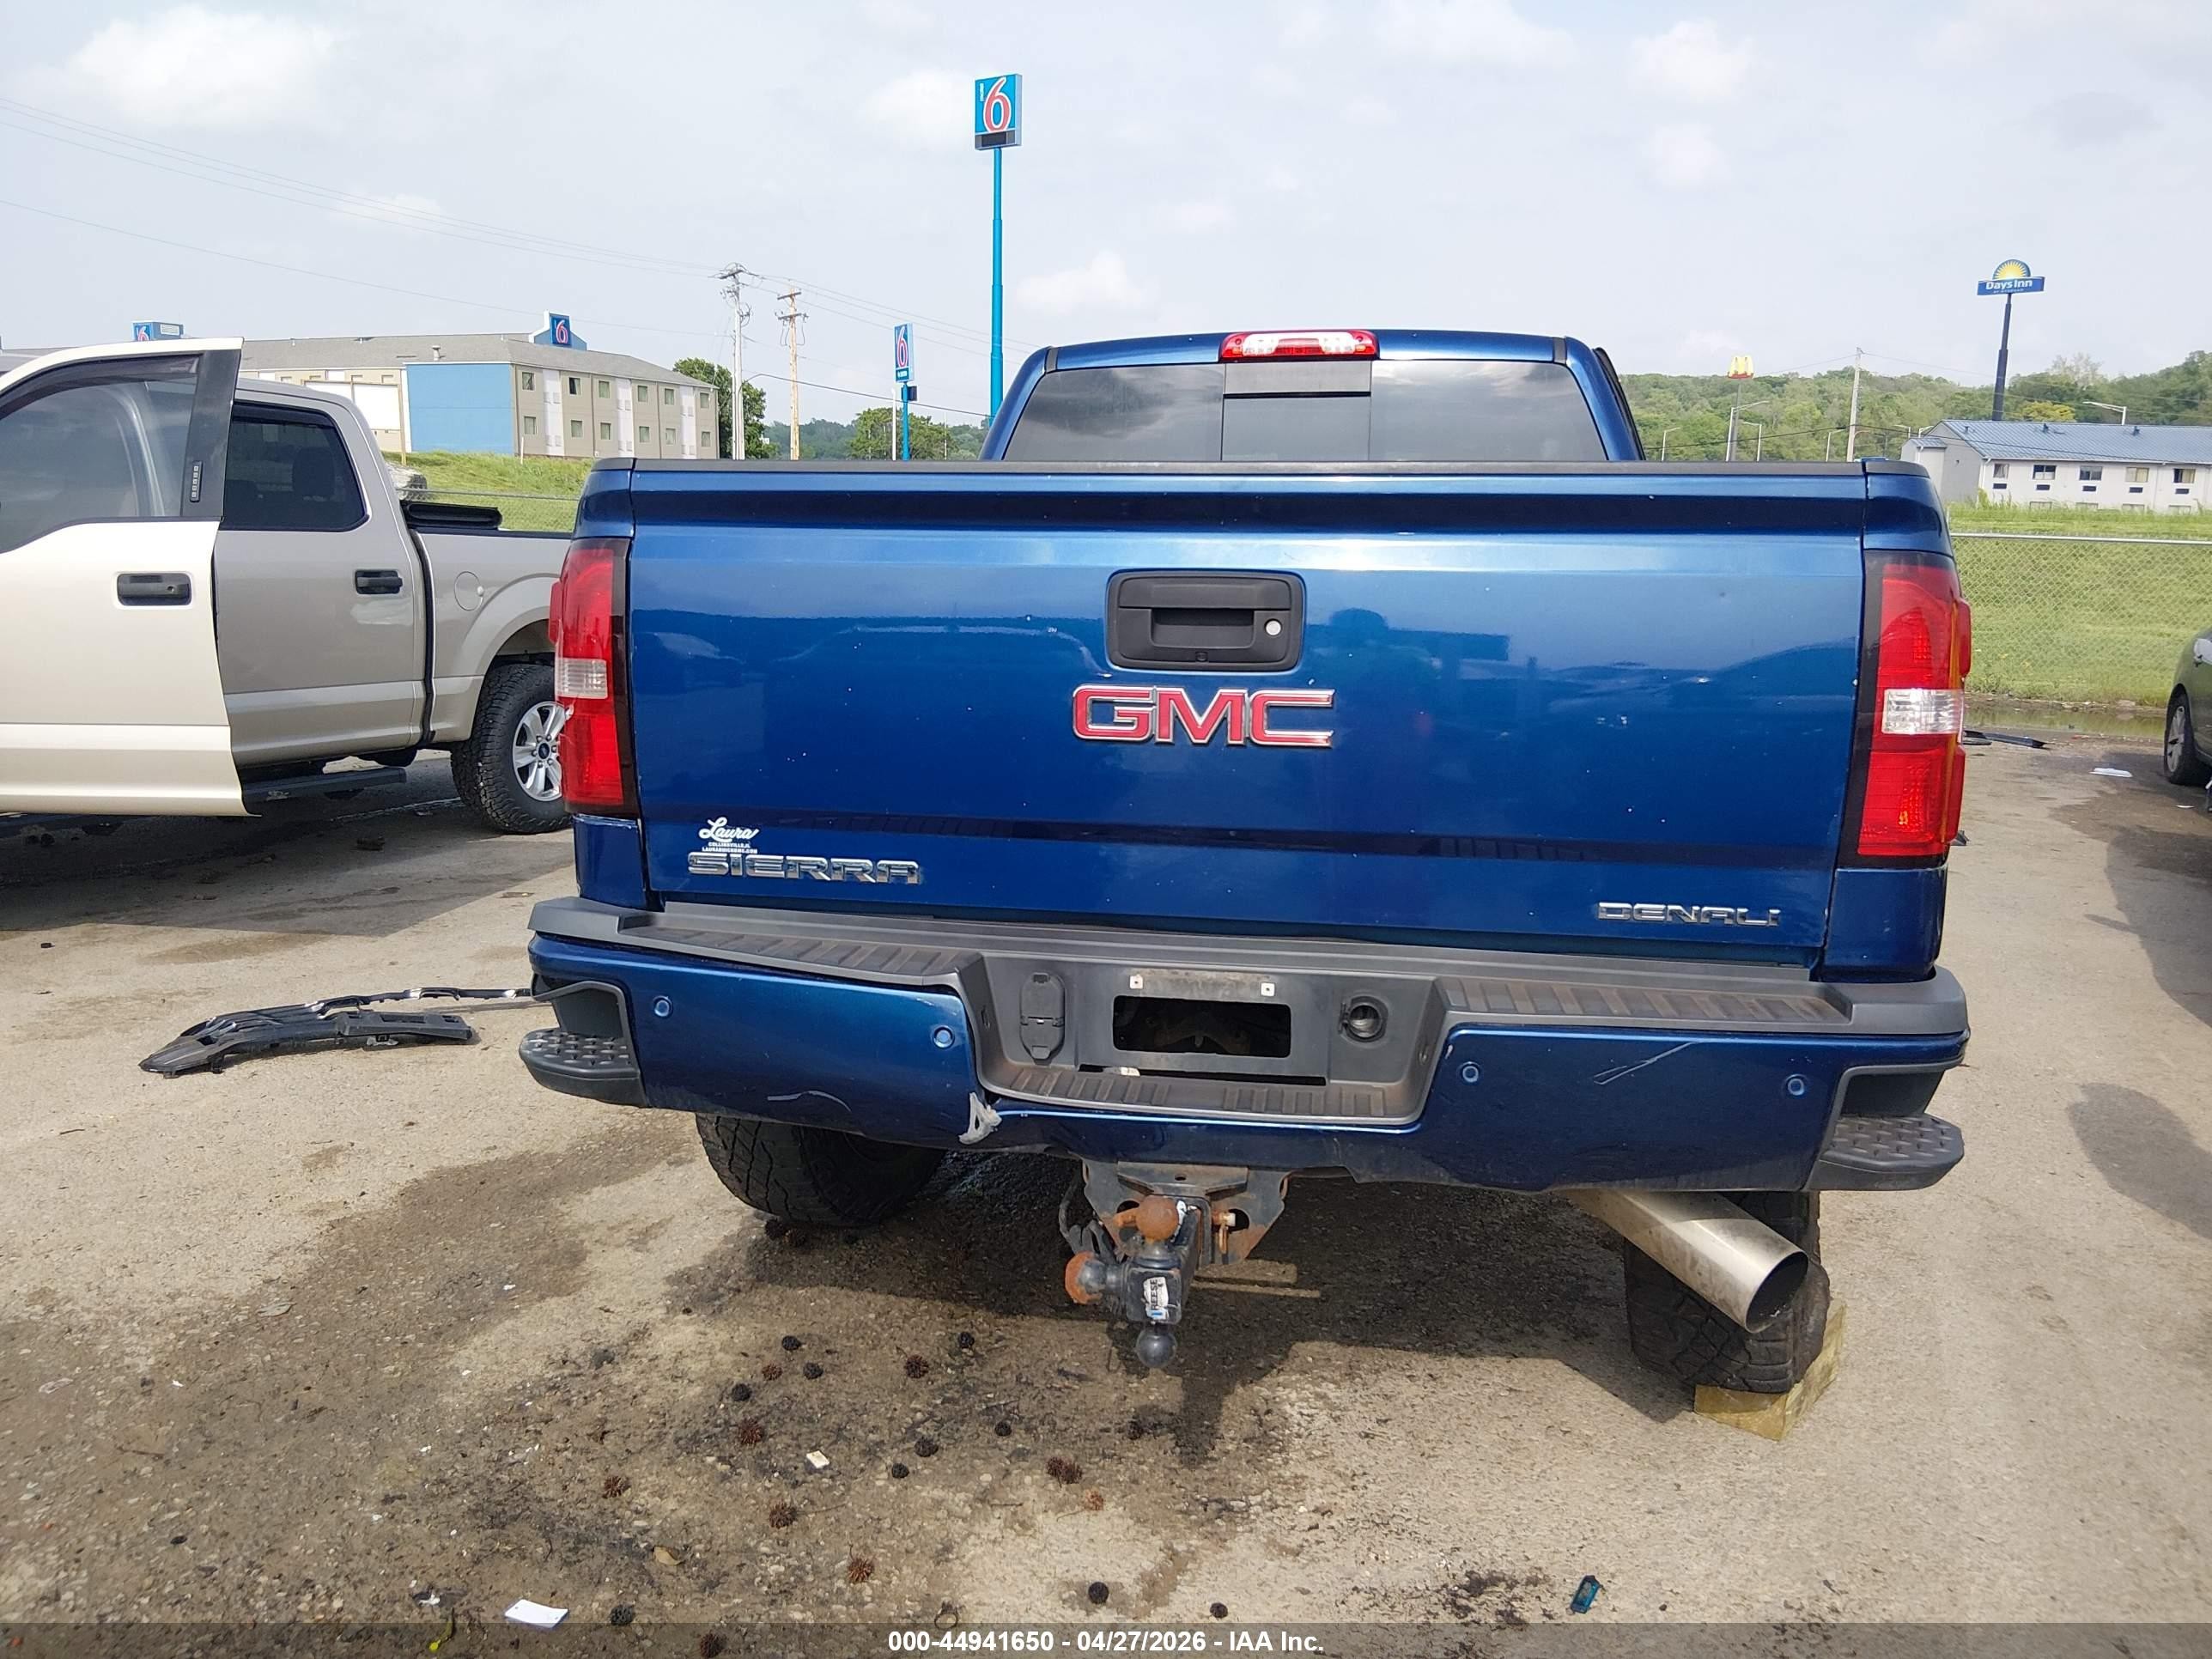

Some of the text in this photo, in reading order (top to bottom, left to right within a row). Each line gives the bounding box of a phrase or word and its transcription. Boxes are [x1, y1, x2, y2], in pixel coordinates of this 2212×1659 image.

[983, 76, 1012, 133] 6
[1985, 279, 2033, 290] Days Inn
[1073, 684, 1336, 749] GMC
[698, 817, 760, 843] Laura
[687, 851, 921, 884] SIERRA
[1597, 902, 1782, 927] DENALI
